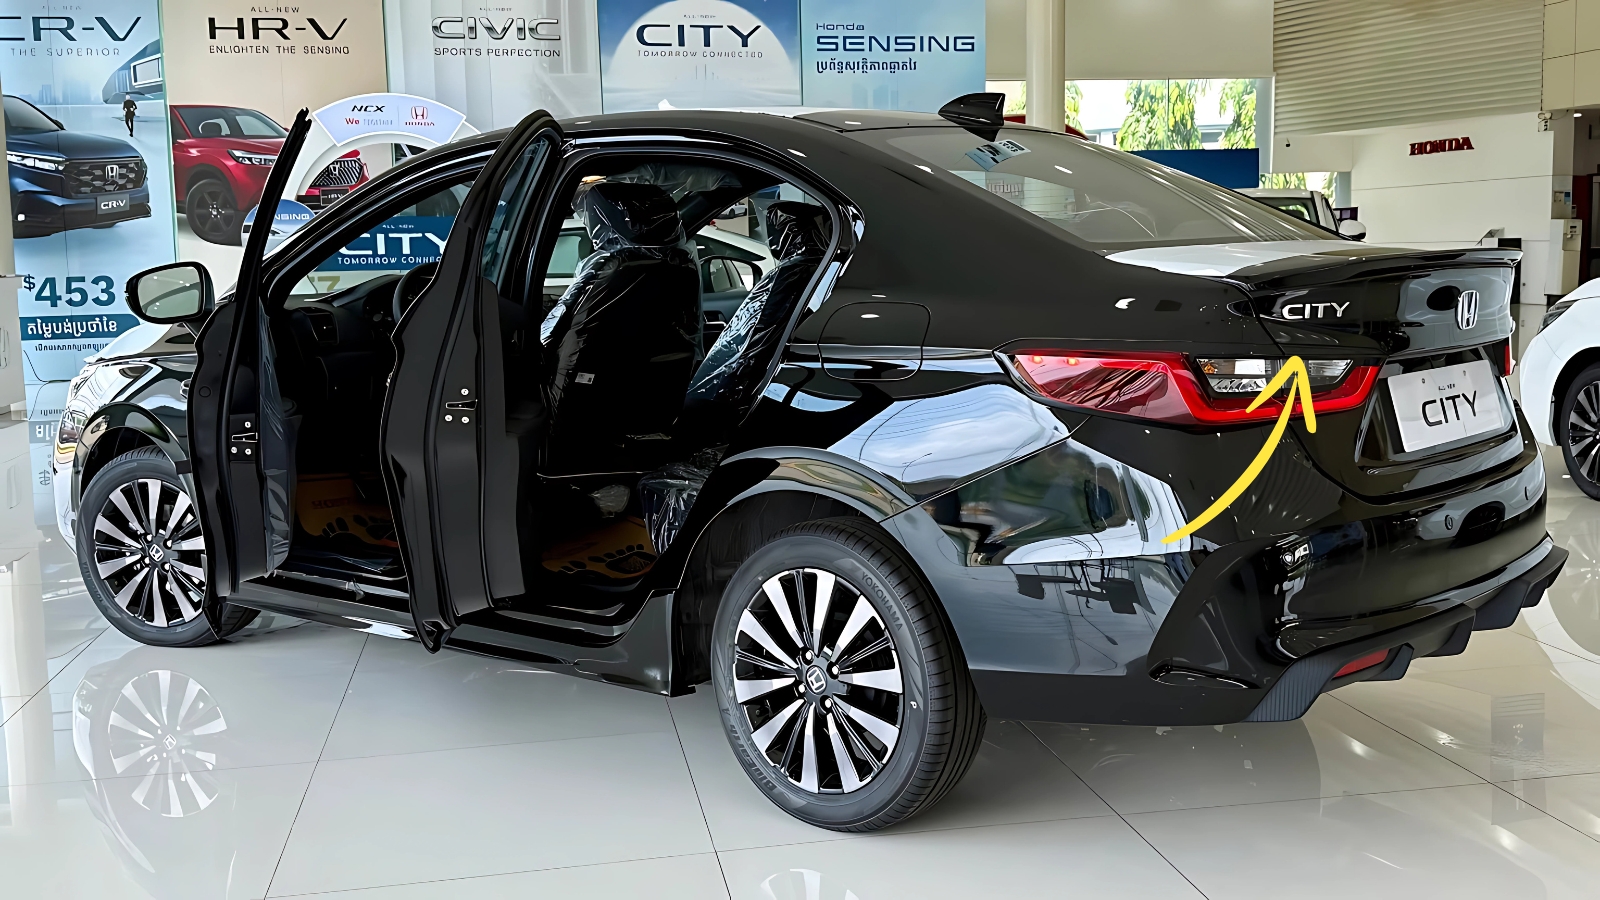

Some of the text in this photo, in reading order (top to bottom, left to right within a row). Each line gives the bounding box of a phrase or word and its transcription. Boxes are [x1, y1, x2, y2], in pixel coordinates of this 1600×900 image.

[208, 17, 348, 41] HR-V
[431, 16, 561, 41] CIVIC
[636, 23, 762, 48] CITY
[816, 22, 865, 31] Honda
[11, 47, 121, 57] THE SUPERIOR
[209, 45, 350, 55] ENLIGHTEN THE SENSING
[434, 47, 561, 57] SPORTS PERFECTION
[816, 35, 975, 53] SENSING
[638, 50, 698, 58] TOMORROW
[351, 104, 386, 113] NCX
[1409, 136, 1475, 156] HONDA
[337, 256, 398, 265] TOMORROW
[1281, 301, 1350, 320] CITY
[1421, 390, 1477, 427] CITY
[862, 571, 903, 631] YOKOHAMA
